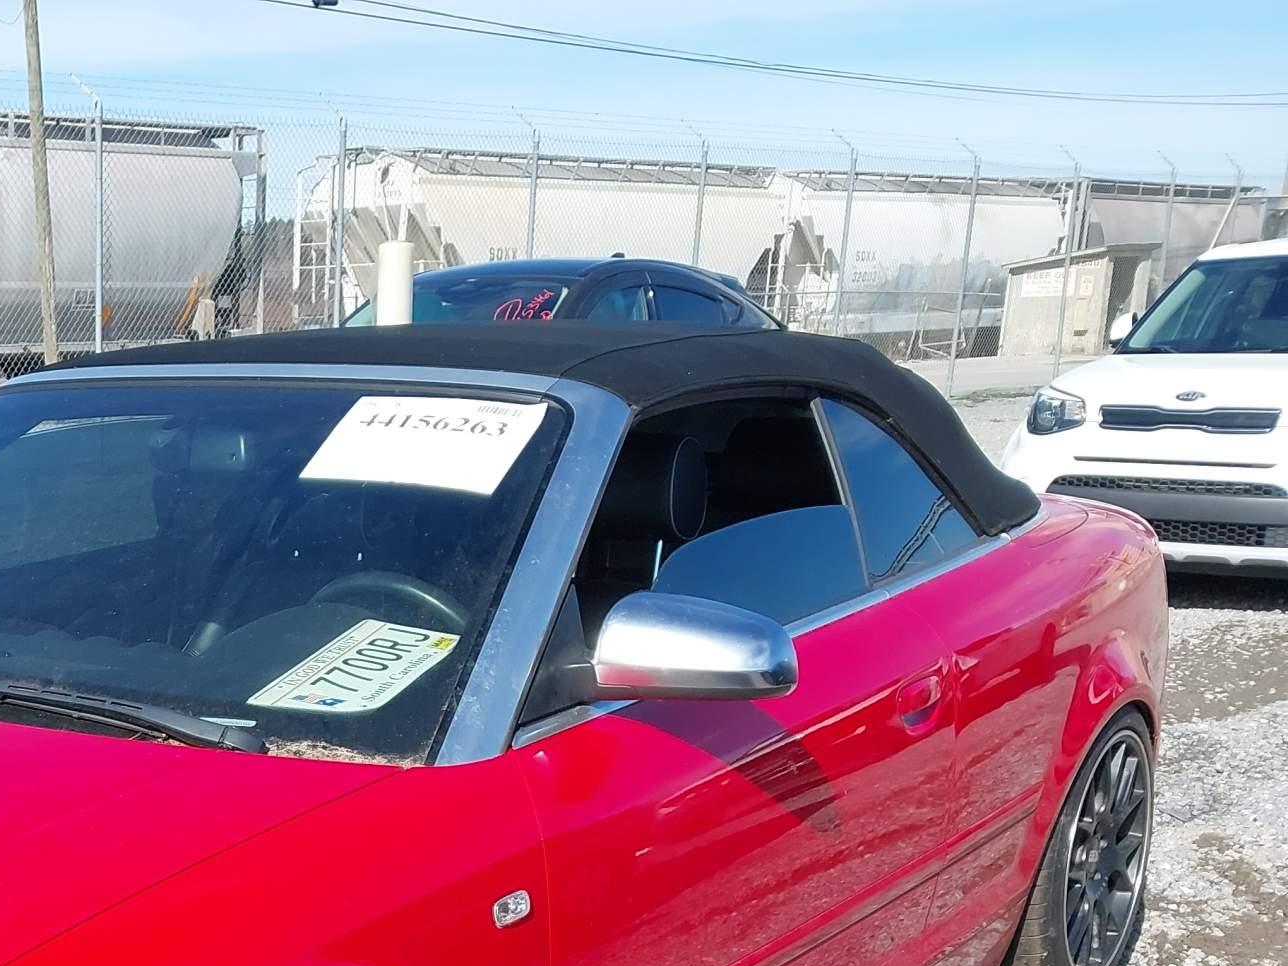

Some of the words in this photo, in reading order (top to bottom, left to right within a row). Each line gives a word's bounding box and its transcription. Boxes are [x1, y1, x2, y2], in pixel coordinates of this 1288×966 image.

[489, 247, 518, 261] SOXX
[359, 412, 509, 437] 44156263
[283, 677, 303, 686] IN
[295, 664, 321, 678] GOD
[312, 650, 335, 663] WE
[329, 636, 358, 655] TRUST
[309, 627, 430, 692] 7700RJ
[361, 681, 396, 702] South
[389, 653, 433, 681] Carolina
